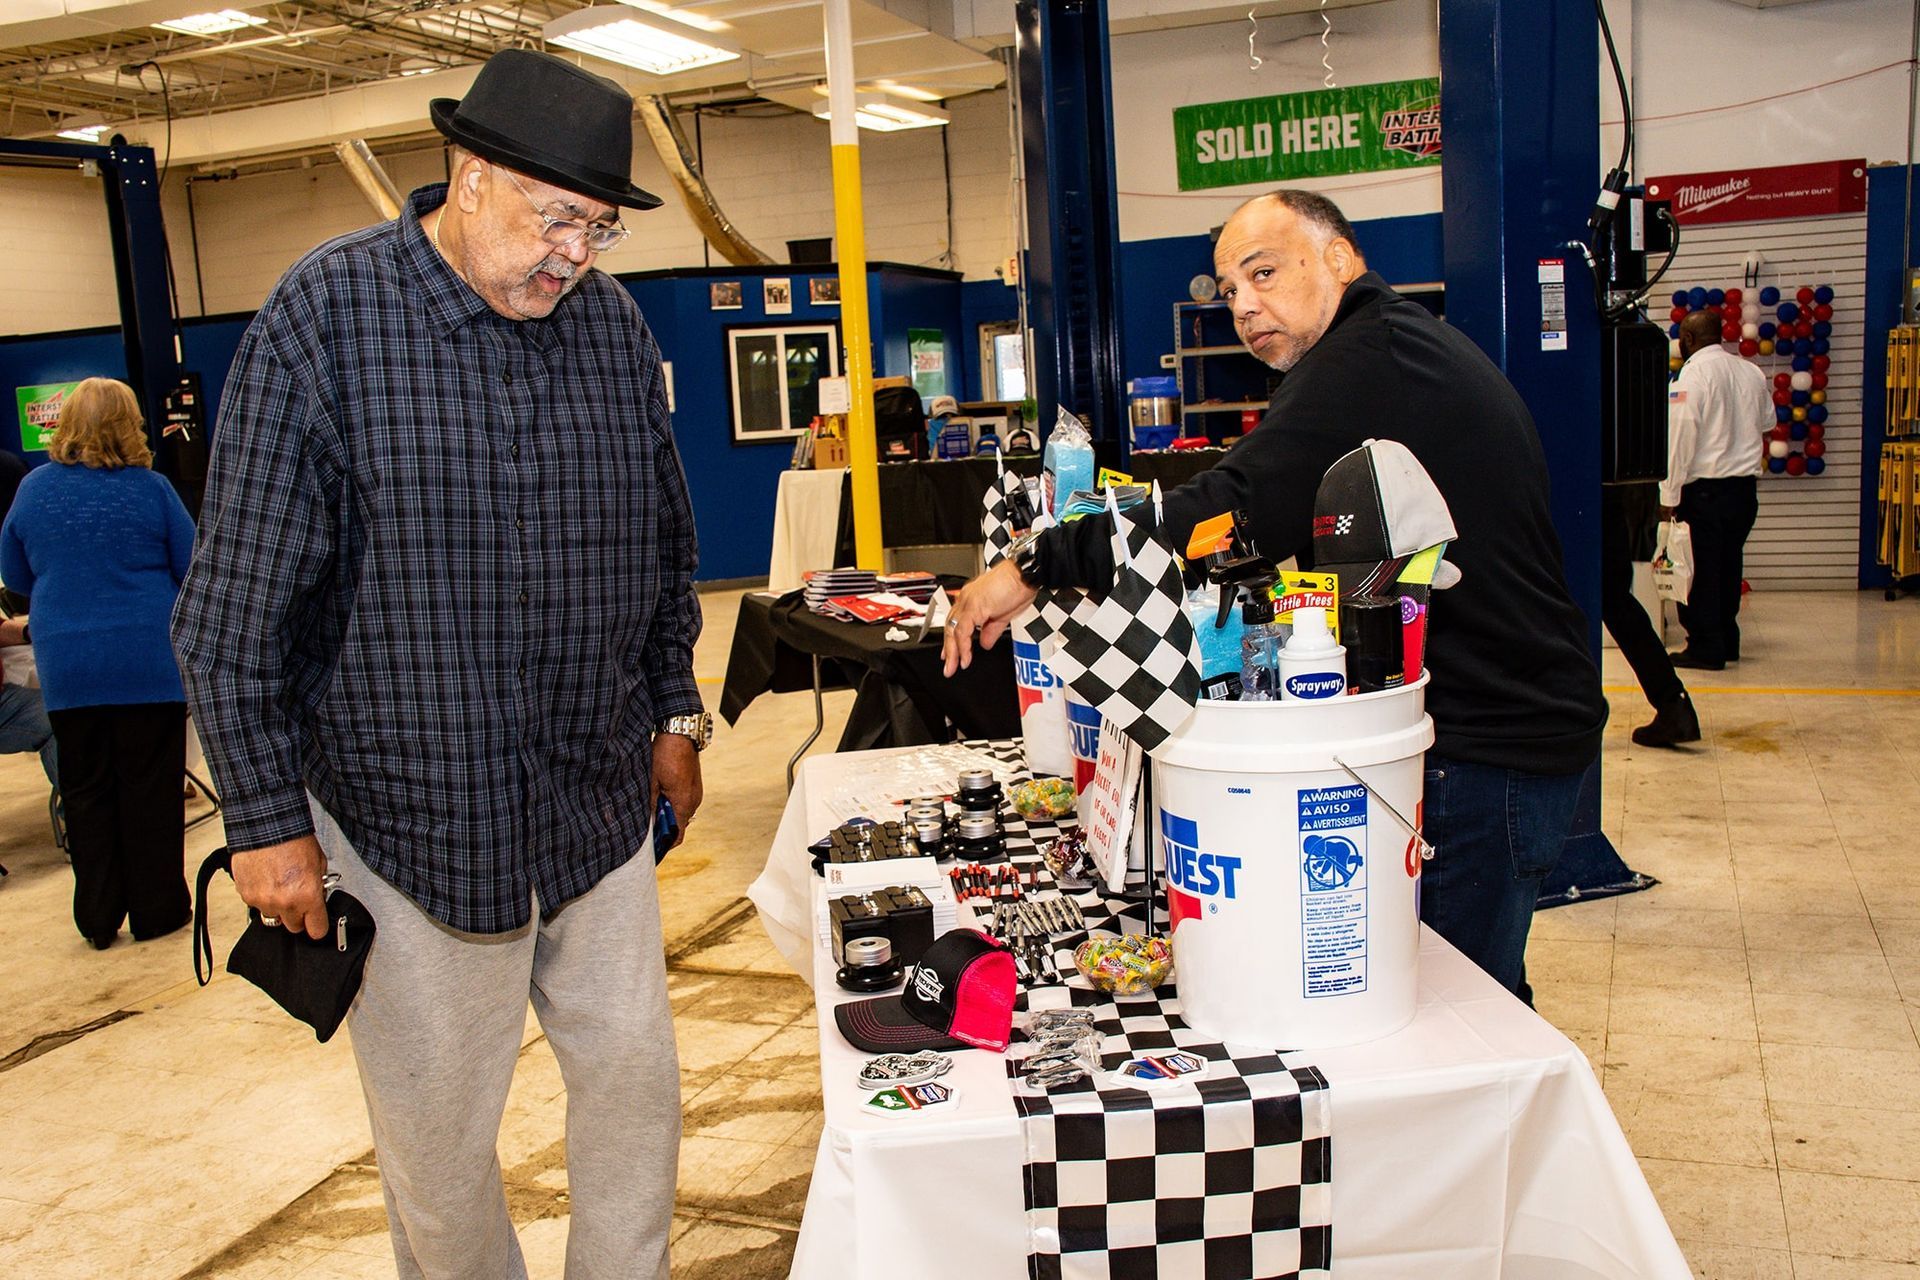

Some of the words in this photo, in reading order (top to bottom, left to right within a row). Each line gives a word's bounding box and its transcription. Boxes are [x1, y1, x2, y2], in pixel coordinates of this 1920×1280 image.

[1196, 123, 1274, 164] SOLD
[1281, 113, 1361, 155] HERE
[1389, 128, 1441, 145] BATT
[1675, 177, 1751, 208] Milwaukee
[1784, 190, 1809, 198] HEAVY
[1324, 577, 1335, 591] 3
[1273, 594, 1301, 614] Little
[1304, 592, 1334, 607] Trees
[1291, 678, 1341, 695] Sprayway
[1311, 787, 1365, 802] WARNING
[1313, 803, 1350, 815] AVISO
[1313, 814, 1366, 829] AVERTISSEMENT
[1162, 835, 1242, 899] UEST
